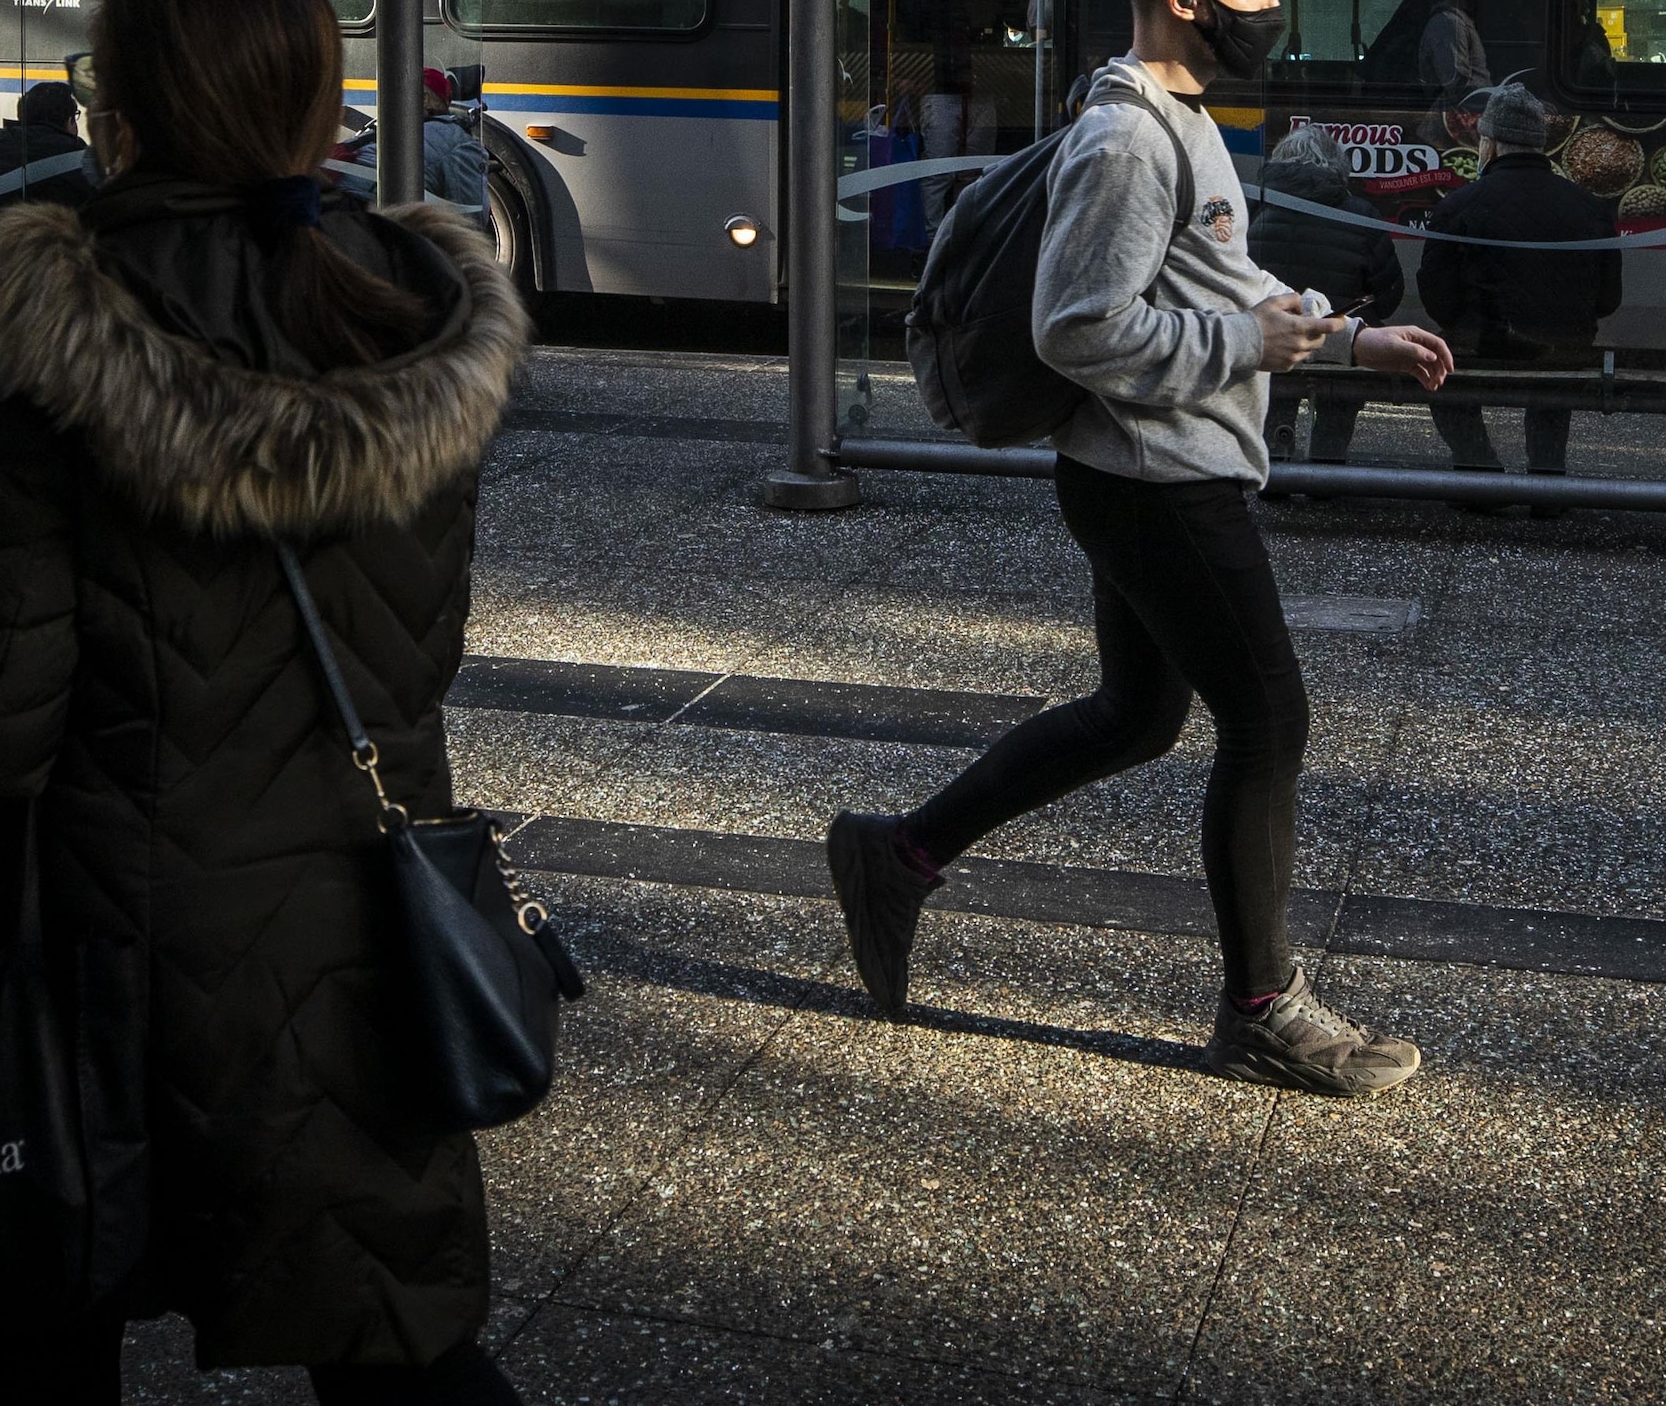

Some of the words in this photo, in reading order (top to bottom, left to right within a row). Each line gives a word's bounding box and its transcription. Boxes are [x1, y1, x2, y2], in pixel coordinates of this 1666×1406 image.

[1290, 117, 1403, 145] Fmous
[1380, 177, 1418, 190] VANCOUVER
[1434, 173, 1452, 183] 1929
